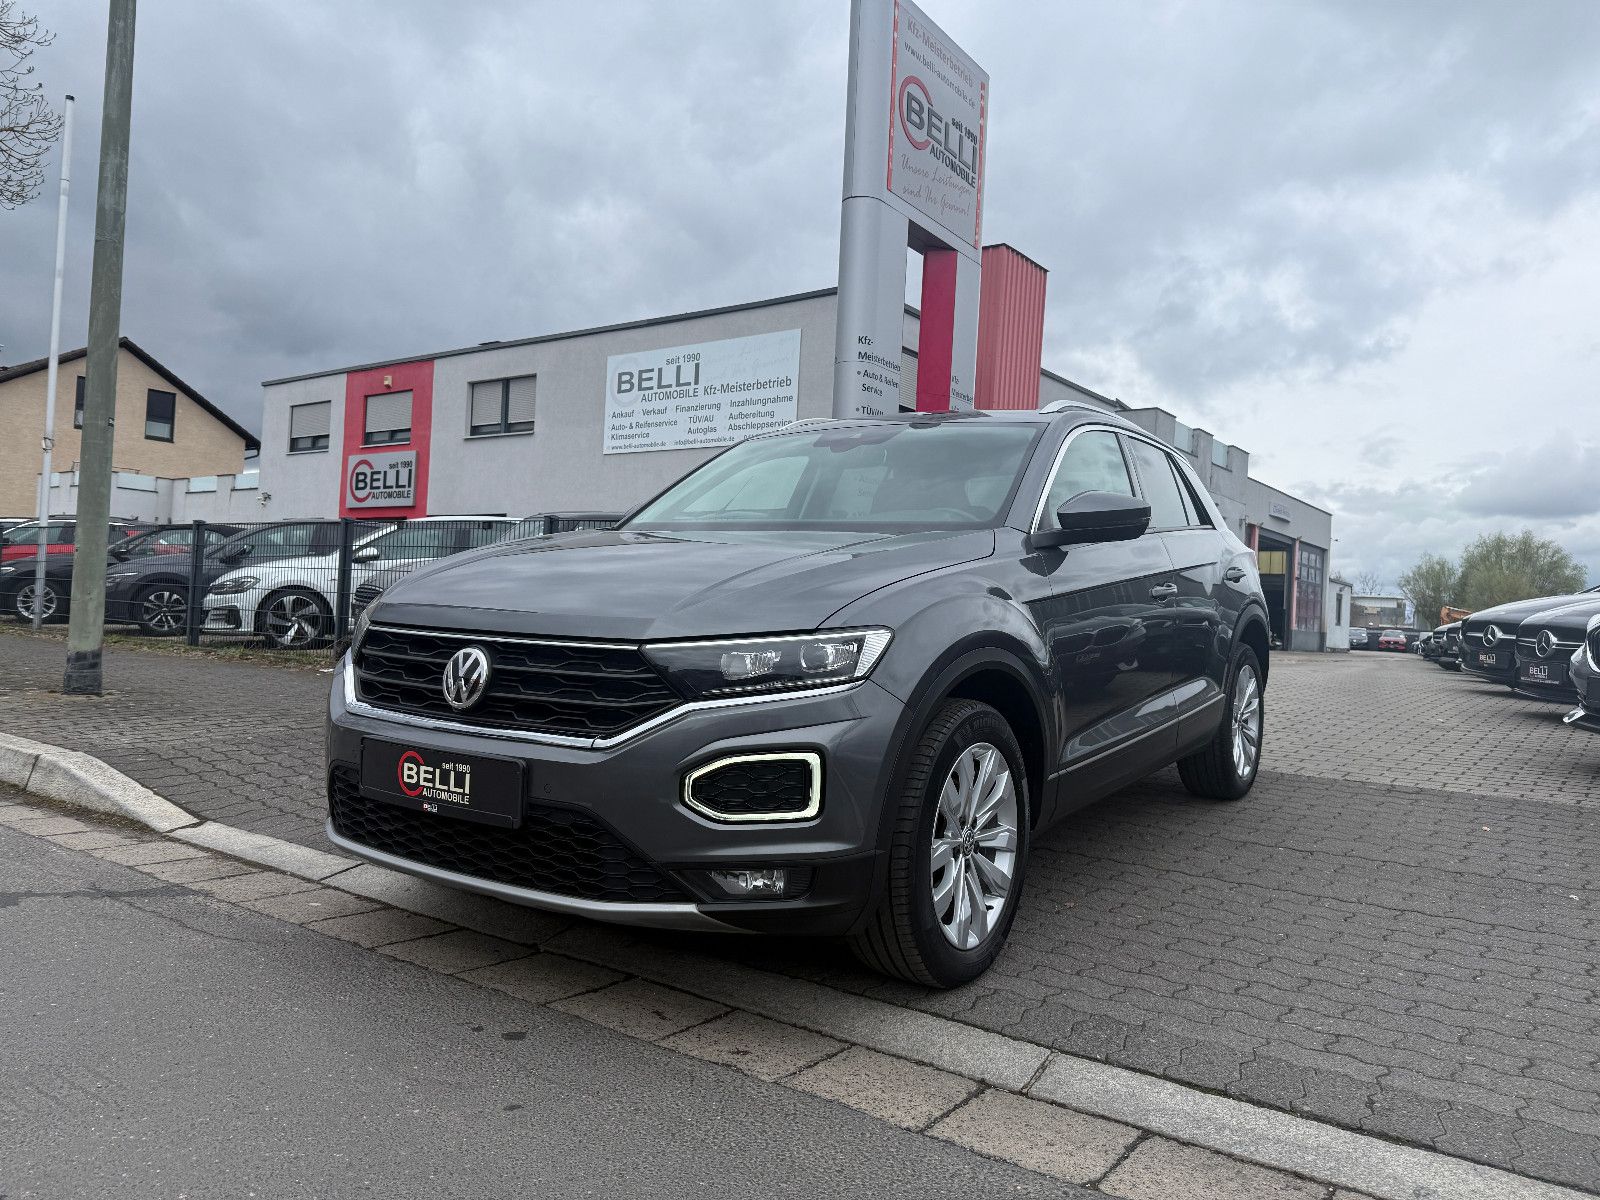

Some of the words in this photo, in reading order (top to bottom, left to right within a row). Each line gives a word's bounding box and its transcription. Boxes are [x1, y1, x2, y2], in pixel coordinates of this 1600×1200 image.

[907, 17, 974, 88] Kfz-Meisterbetrieb
[906, 91, 978, 175] BELLI
[951, 117, 964, 133] seit
[964, 124, 978, 145] 1990
[929, 143, 976, 189] AUTOMOBILE
[858, 335, 874, 346] Kfz-
[665, 353, 680, 366] seit
[682, 352, 701, 364] 1990
[858, 351, 901, 372] Meisterbetrieb
[616, 362, 701, 395] BELLI
[862, 369, 879, 381] Auto
[641, 387, 700, 404] AUTOMOBILE
[703, 375, 792, 397] Kfz-Meisterbetrieb
[611, 409, 635, 419] Ankauf
[642, 406, 668, 417] Verkauf
[675, 401, 721, 414] Finanzierung
[729, 394, 794, 409] Inzahlungnahme
[610, 431, 650, 441] Klimaservice
[687, 425, 718, 436] Autoglas
[727, 418, 793, 432] Abschleppservice
[611, 423, 628, 432] Auto-
[635, 418, 678, 430] Reifenservice
[688, 413, 714, 424] TÜV/AU
[728, 408, 775, 421] Aufbereitung
[388, 461, 399, 470] seit
[400, 460, 413, 469] 1990
[354, 469, 412, 491] BELLI
[371, 490, 411, 500] AUTOMOBILE
[403, 762, 471, 795] BELLI
[442, 762, 454, 771] seit
[456, 763, 471, 773] 1990
[422, 787, 470, 805] AUTOMOBILE
